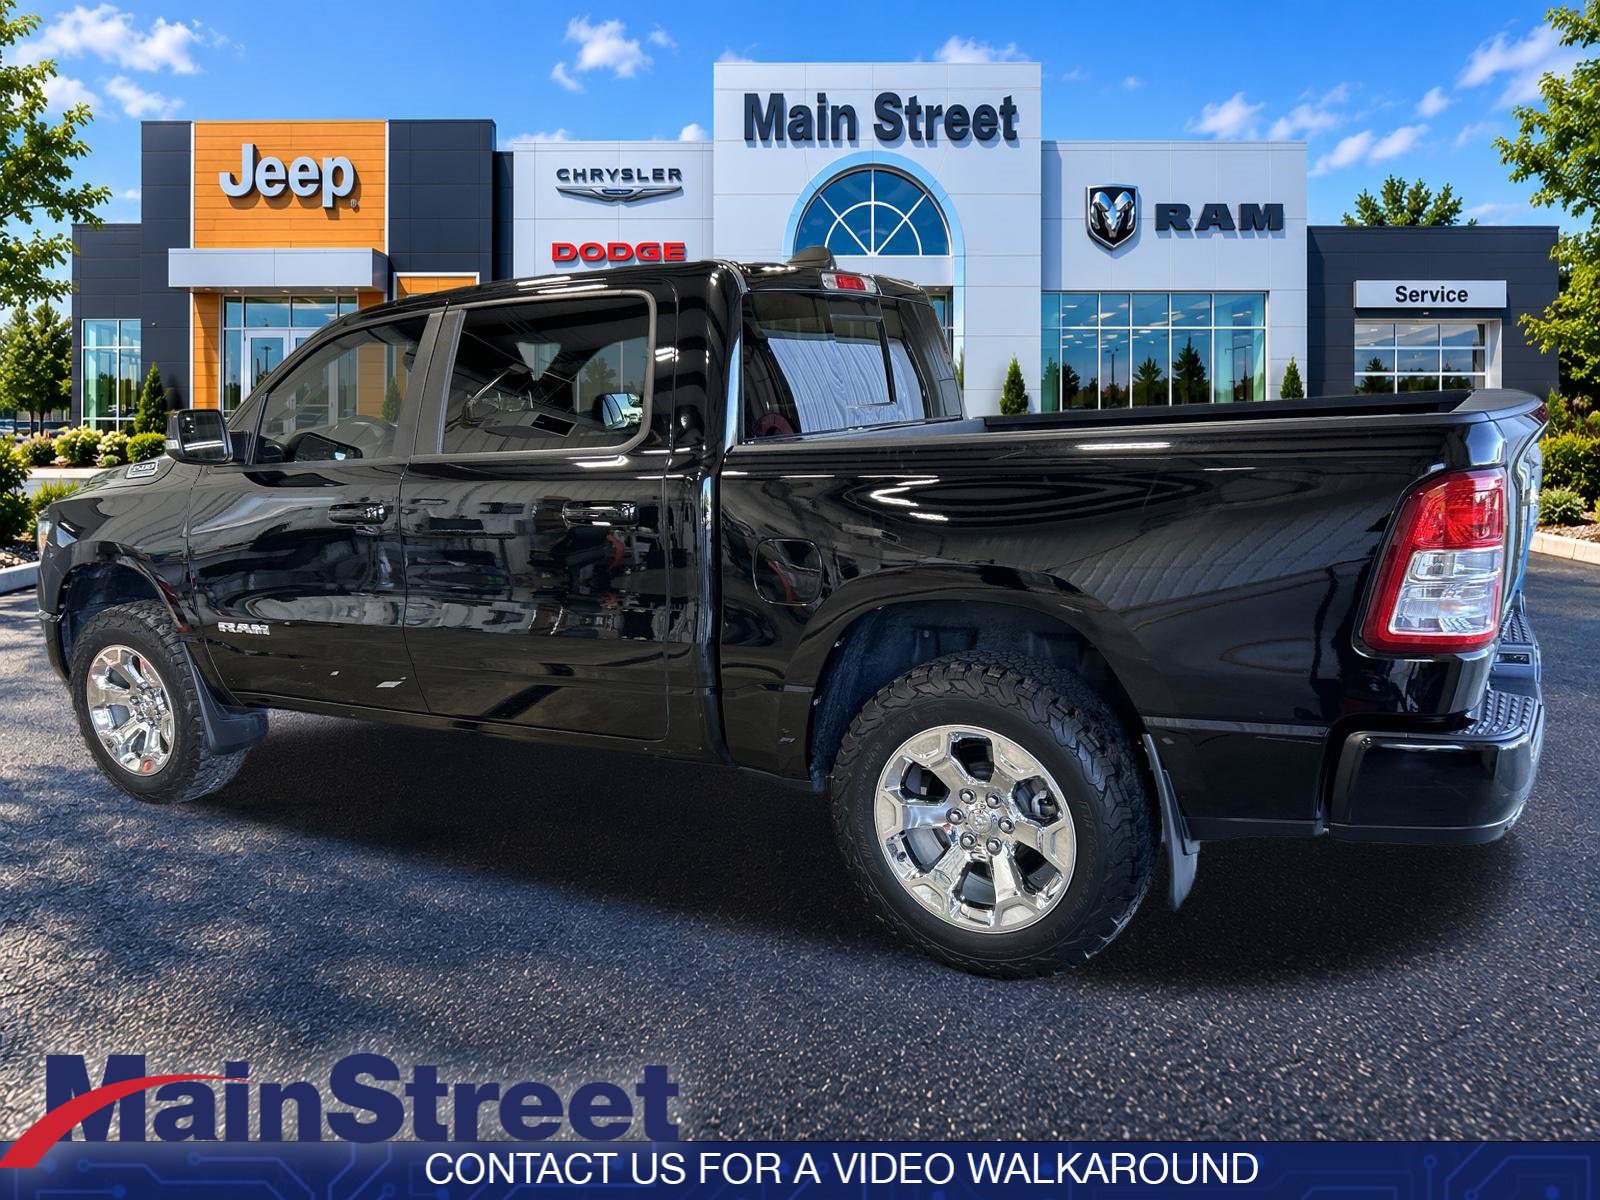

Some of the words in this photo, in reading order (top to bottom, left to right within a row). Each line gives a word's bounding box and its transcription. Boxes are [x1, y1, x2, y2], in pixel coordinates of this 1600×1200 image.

[743, 92, 857, 142] Main
[873, 91, 1018, 142] Street
[218, 143, 356, 209] Jeep
[556, 167, 682, 182] CHRYSLER
[1155, 203, 1284, 232] RAM
[551, 242, 687, 262] DODGE
[1395, 285, 1468, 303] Service
[217, 621, 270, 636] RAM
